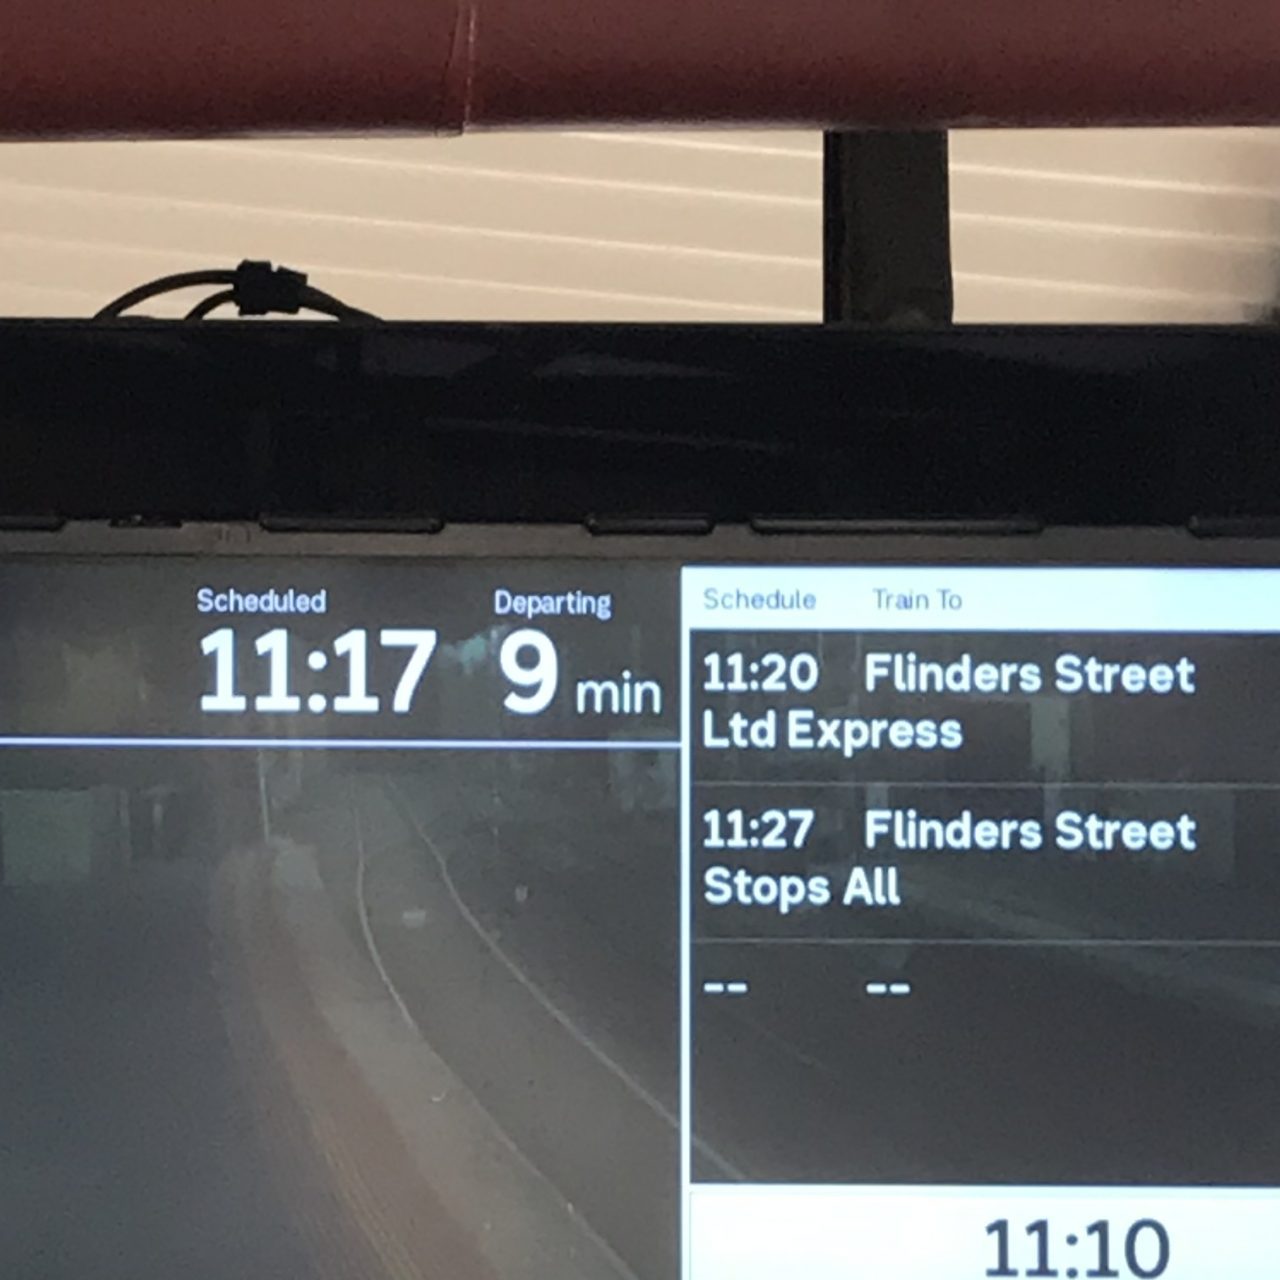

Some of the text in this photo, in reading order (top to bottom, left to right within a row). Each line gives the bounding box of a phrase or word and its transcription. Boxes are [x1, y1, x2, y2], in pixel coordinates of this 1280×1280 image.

[197, 587, 327, 614] Scheduled
[494, 589, 612, 621] Departing
[703, 587, 817, 610] Schedule
[874, 588, 963, 610] Train To
[200, 628, 437, 714] 11:17
[499, 628, 661, 714] 9 min
[703, 652, 819, 692] 11:20
[865, 651, 1196, 693] Flinders Street
[703, 709, 963, 758] Ltd Express
[703, 809, 815, 848] 11:27
[865, 808, 1196, 851] Flinders Street
[704, 866, 901, 915] Stops All
[985, 1218, 1170, 1280] 11:10
